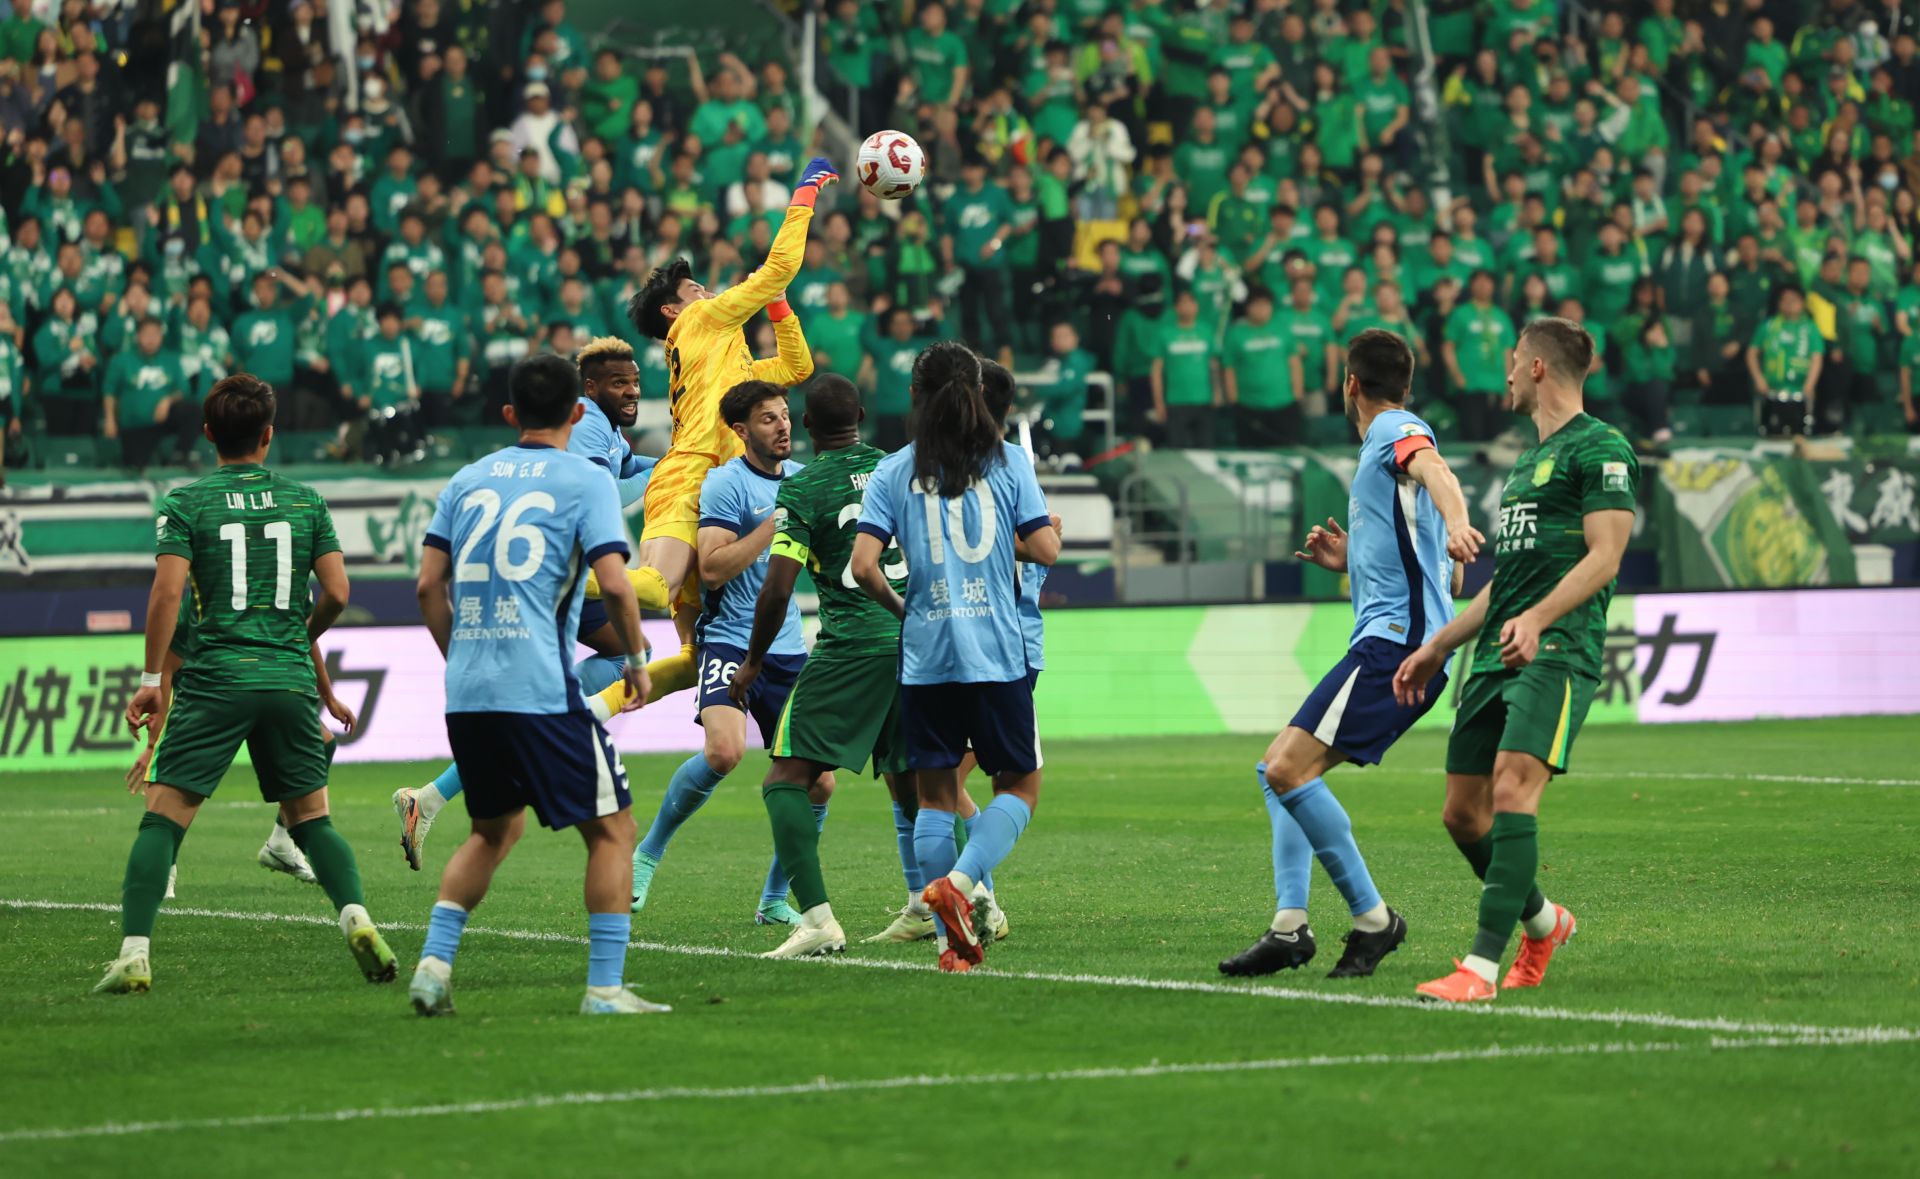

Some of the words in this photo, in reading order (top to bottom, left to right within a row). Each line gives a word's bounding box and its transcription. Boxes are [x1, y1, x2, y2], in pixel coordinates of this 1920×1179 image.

[489, 461, 516, 477] SUN
[225, 493, 246, 510] LIN
[250, 491, 278, 510] L.M.
[911, 475, 997, 565] 10
[455, 488, 556, 583] 26
[220, 521, 292, 611] 11
[930, 577, 987, 605] 绿城
[459, 596, 520, 625] 绿城
[927, 606, 996, 621] GREENTOWN
[453, 627, 531, 641] GREENTOWN
[704, 658, 740, 686] 36
[0, 666, 146, 757] 快速
